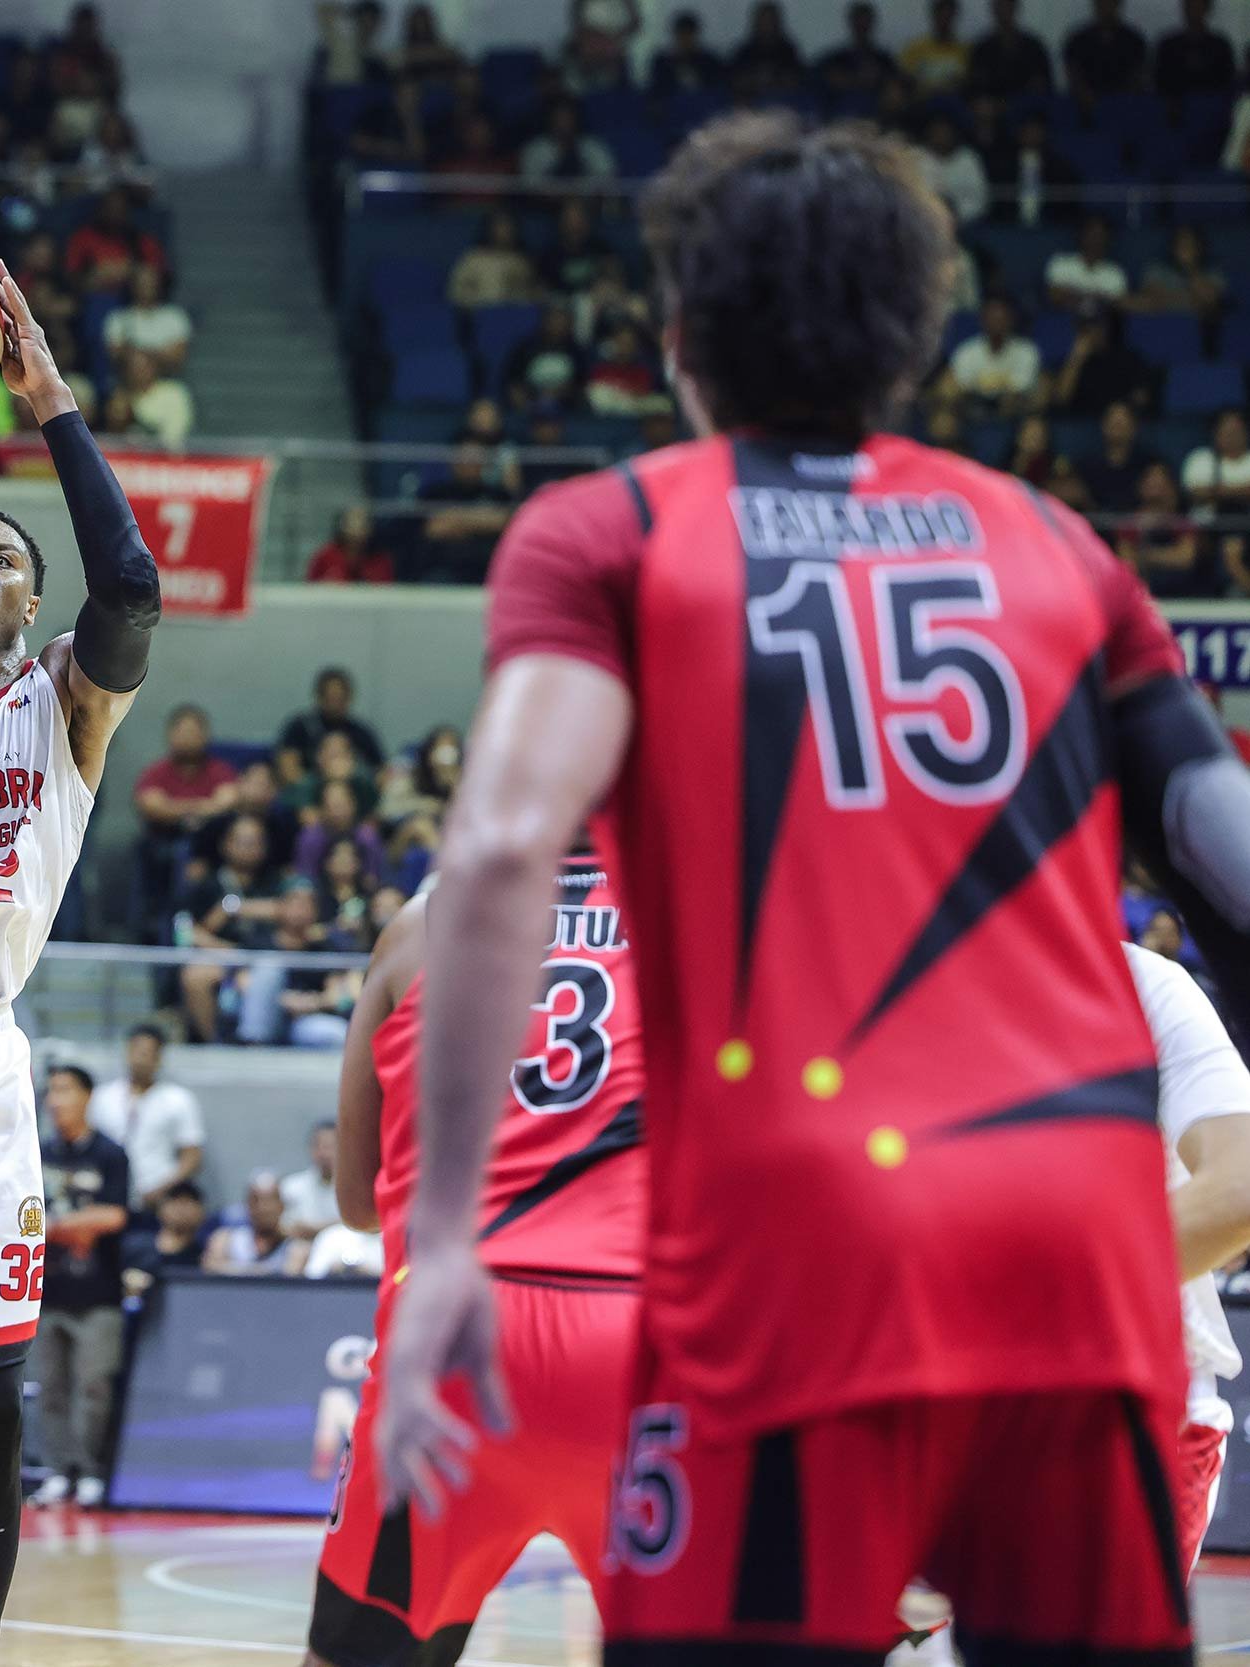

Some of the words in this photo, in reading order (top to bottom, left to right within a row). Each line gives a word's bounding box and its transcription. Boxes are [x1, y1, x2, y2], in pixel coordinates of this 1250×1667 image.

[747, 561, 1027, 810] 15
[510, 957, 615, 1115] 3
[0, 1243, 45, 1301] 32
[600, 1402, 693, 1577] 5
